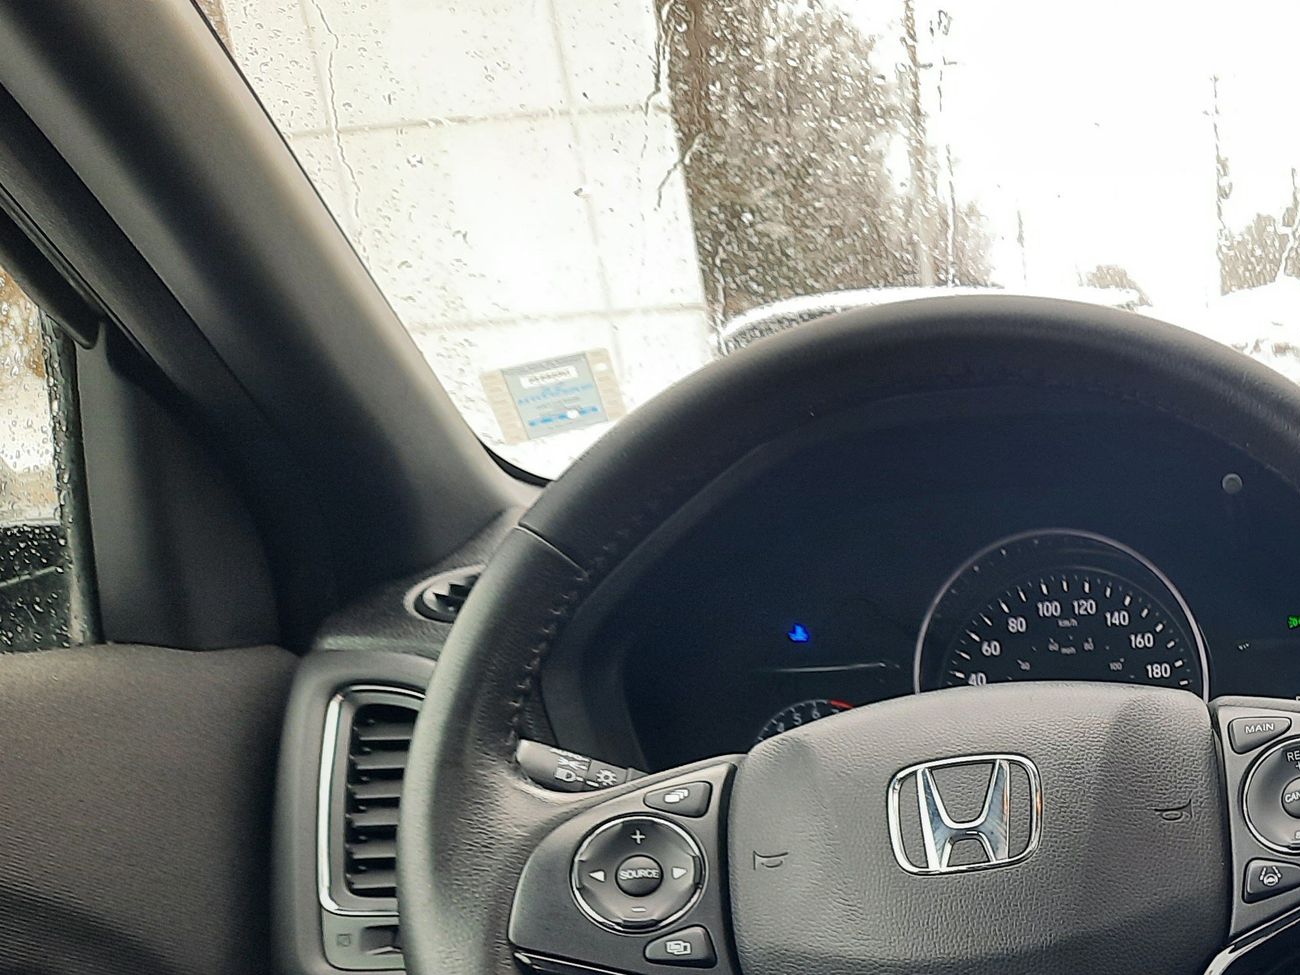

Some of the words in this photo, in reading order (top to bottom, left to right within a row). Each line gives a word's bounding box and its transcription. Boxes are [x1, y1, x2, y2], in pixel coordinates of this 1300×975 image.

[1038, 602, 1061, 617] 100
[1073, 600, 1096, 615] 120
[1008, 617, 1026, 632] 80
[1105, 611, 1129, 626] 140
[982, 641, 1000, 656] 60
[1130, 633, 1154, 649] 160
[1146, 663, 1171, 678] 180
[968, 673, 987, 686] 40
[1244, 722, 1275, 734] MAIN
[618, 868, 660, 881] SOURCE
